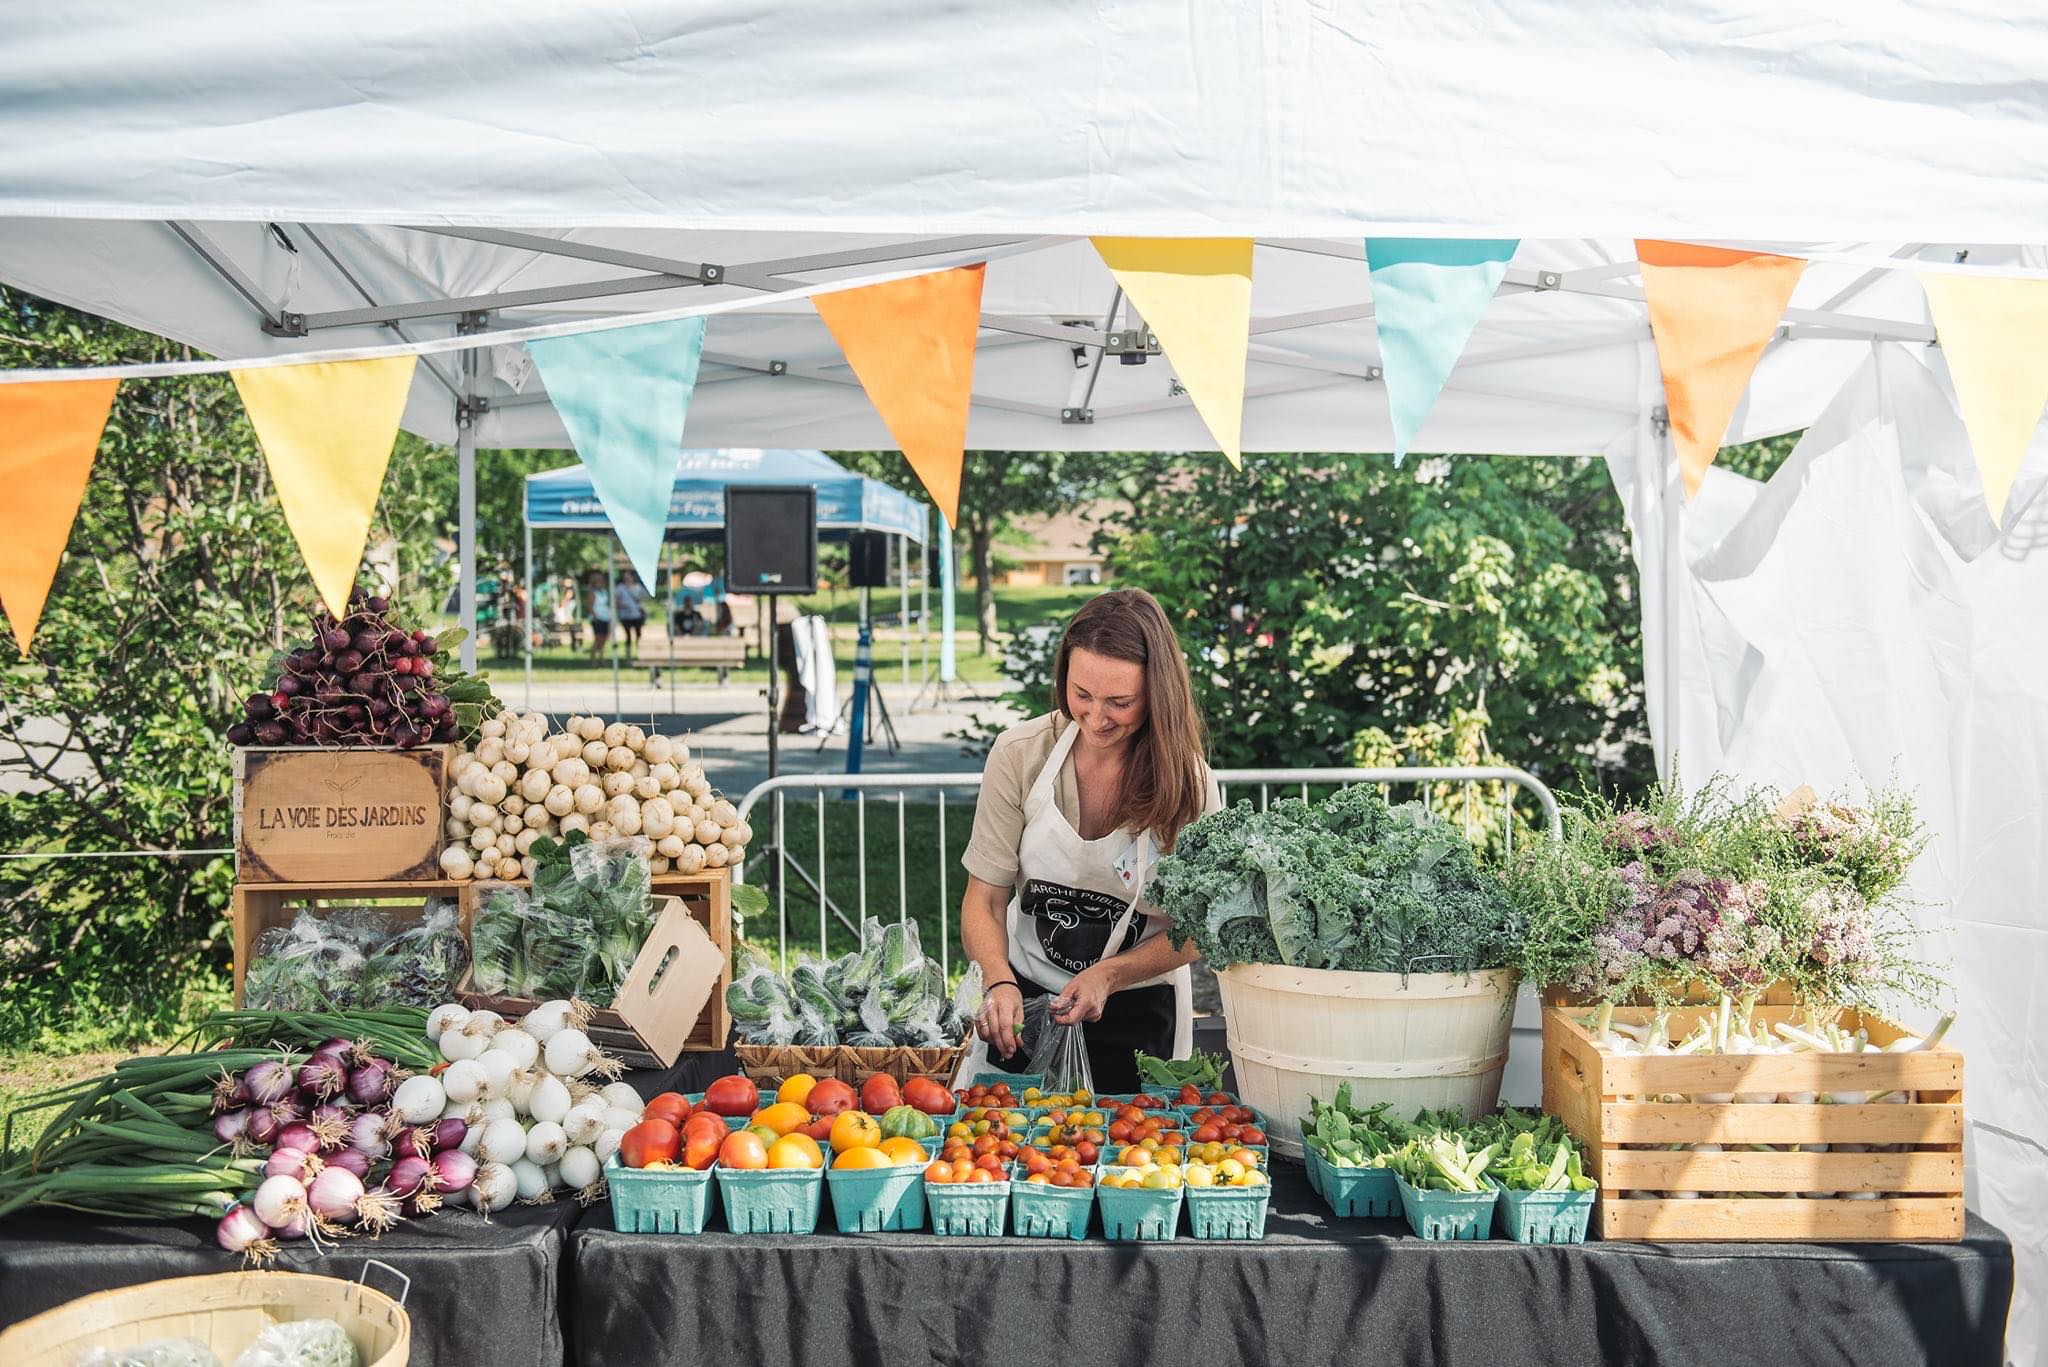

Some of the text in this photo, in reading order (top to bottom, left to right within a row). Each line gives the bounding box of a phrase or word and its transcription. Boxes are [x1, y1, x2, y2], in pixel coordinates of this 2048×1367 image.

[260, 805, 427, 829] LA VOIE DES JARDINS
[1080, 892, 1127, 911] PUBLIC
